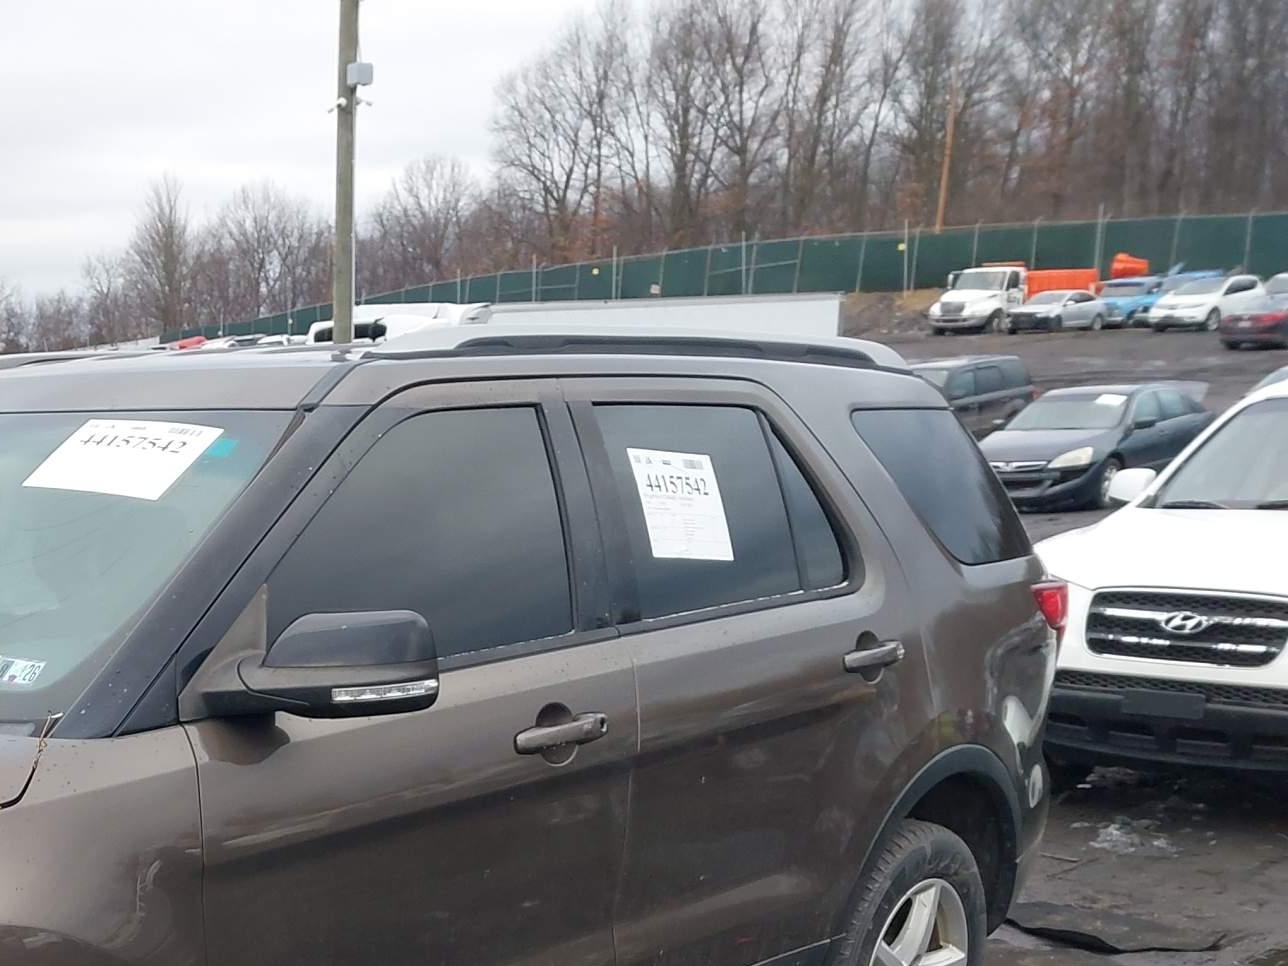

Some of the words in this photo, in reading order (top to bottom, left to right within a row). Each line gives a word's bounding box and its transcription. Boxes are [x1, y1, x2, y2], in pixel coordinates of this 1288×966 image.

[79, 433, 188, 454] 44157542
[645, 473, 710, 496] 44157542
[22, 663, 41, 682] 26
